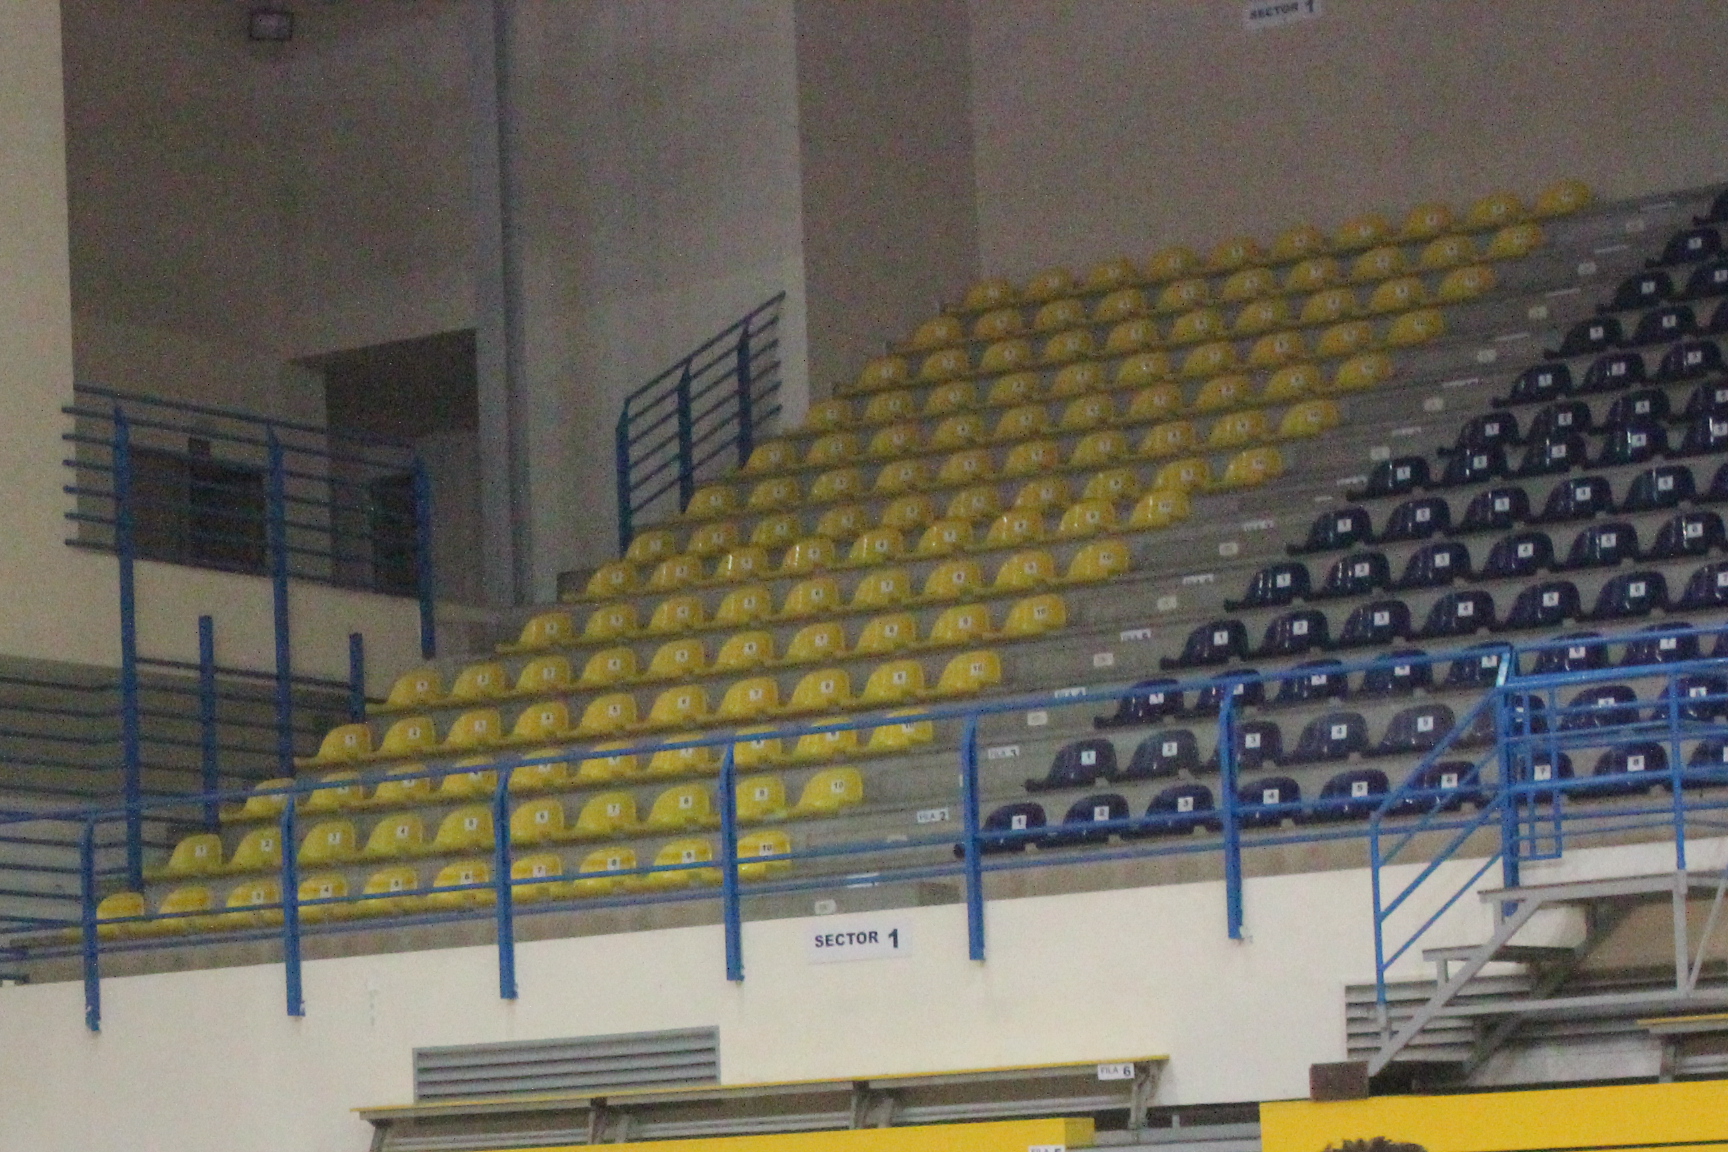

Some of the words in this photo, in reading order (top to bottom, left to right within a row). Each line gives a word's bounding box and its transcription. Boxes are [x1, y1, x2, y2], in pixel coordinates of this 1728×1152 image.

[815, 930, 879, 948] SECTOR
[888, 928, 899, 948] 1
[1100, 1065, 1119, 1076] FILA
[1123, 1065, 1132, 1077] 6
